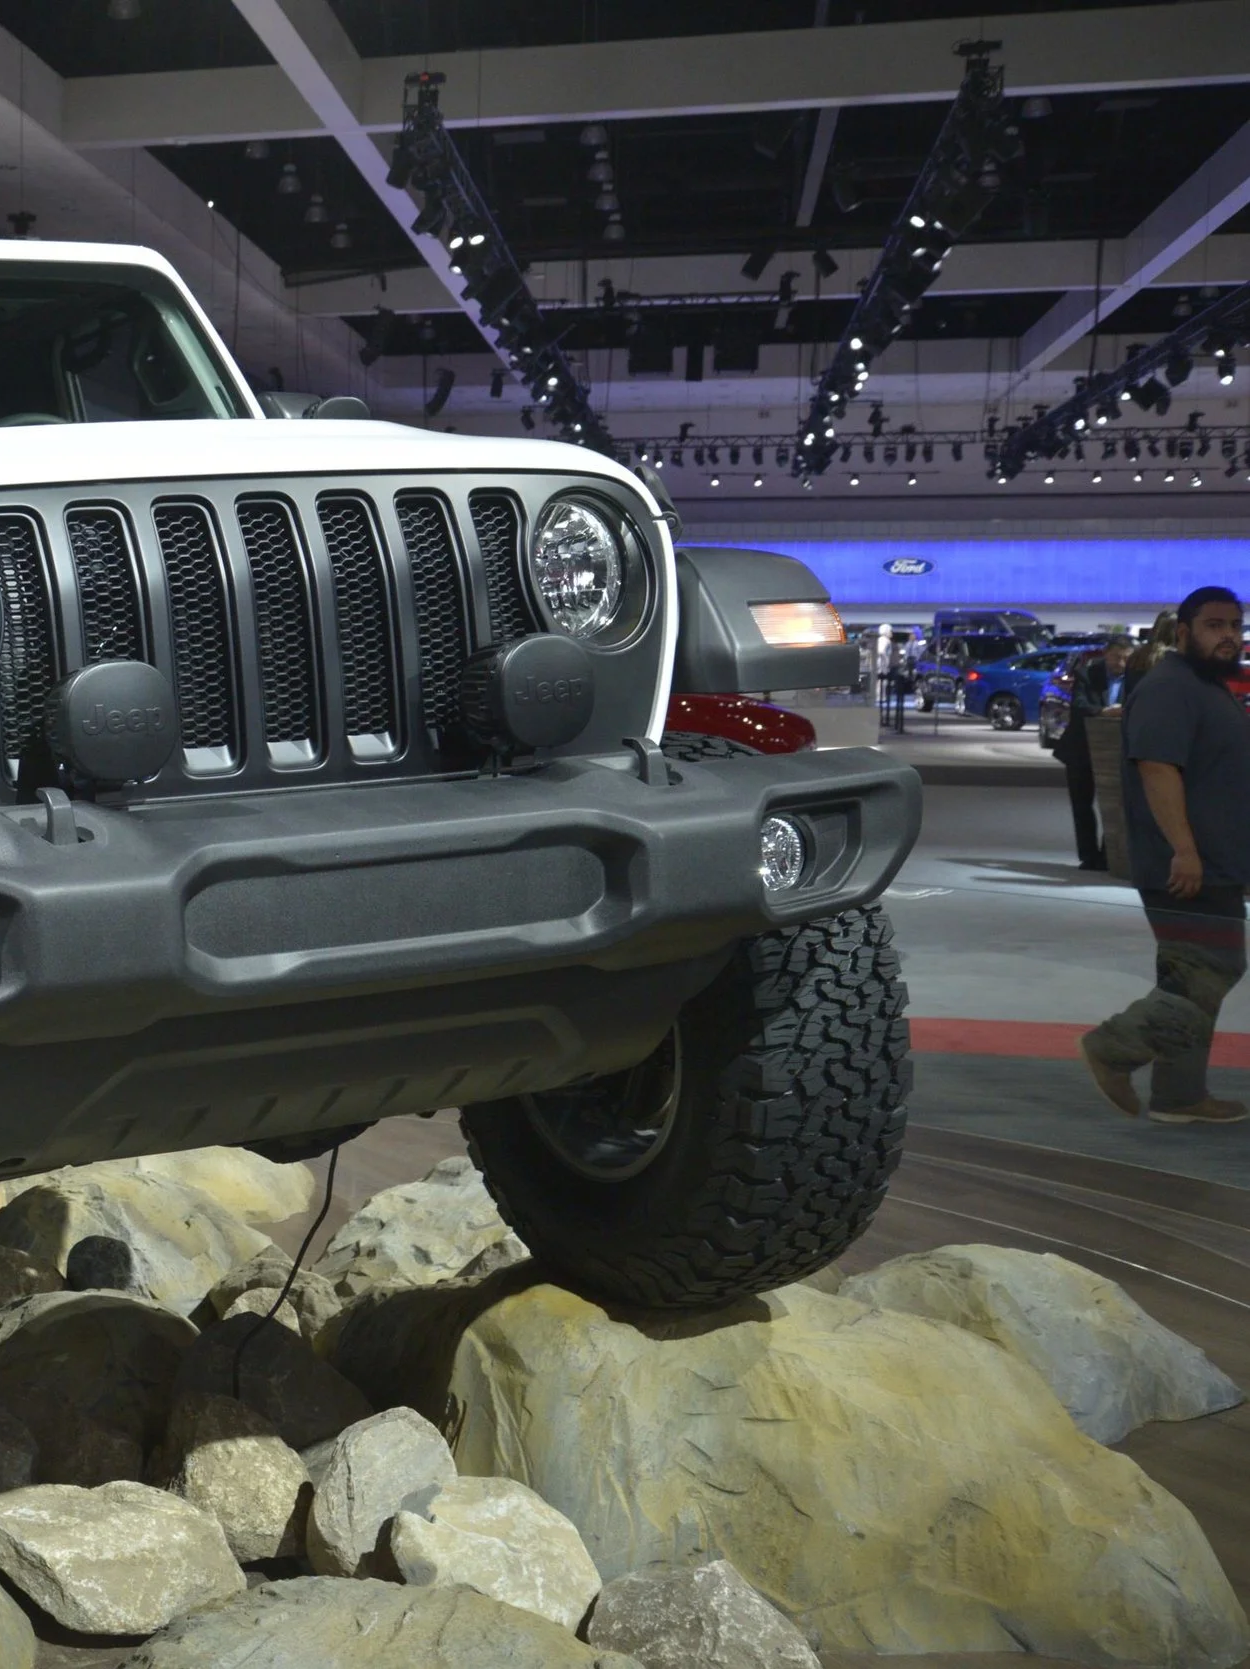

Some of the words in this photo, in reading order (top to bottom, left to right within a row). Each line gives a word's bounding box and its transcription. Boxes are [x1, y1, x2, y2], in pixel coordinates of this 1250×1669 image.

[889, 558, 928, 574] Ford
[514, 675, 587, 706] Jeep
[82, 703, 166, 736] Jeep
